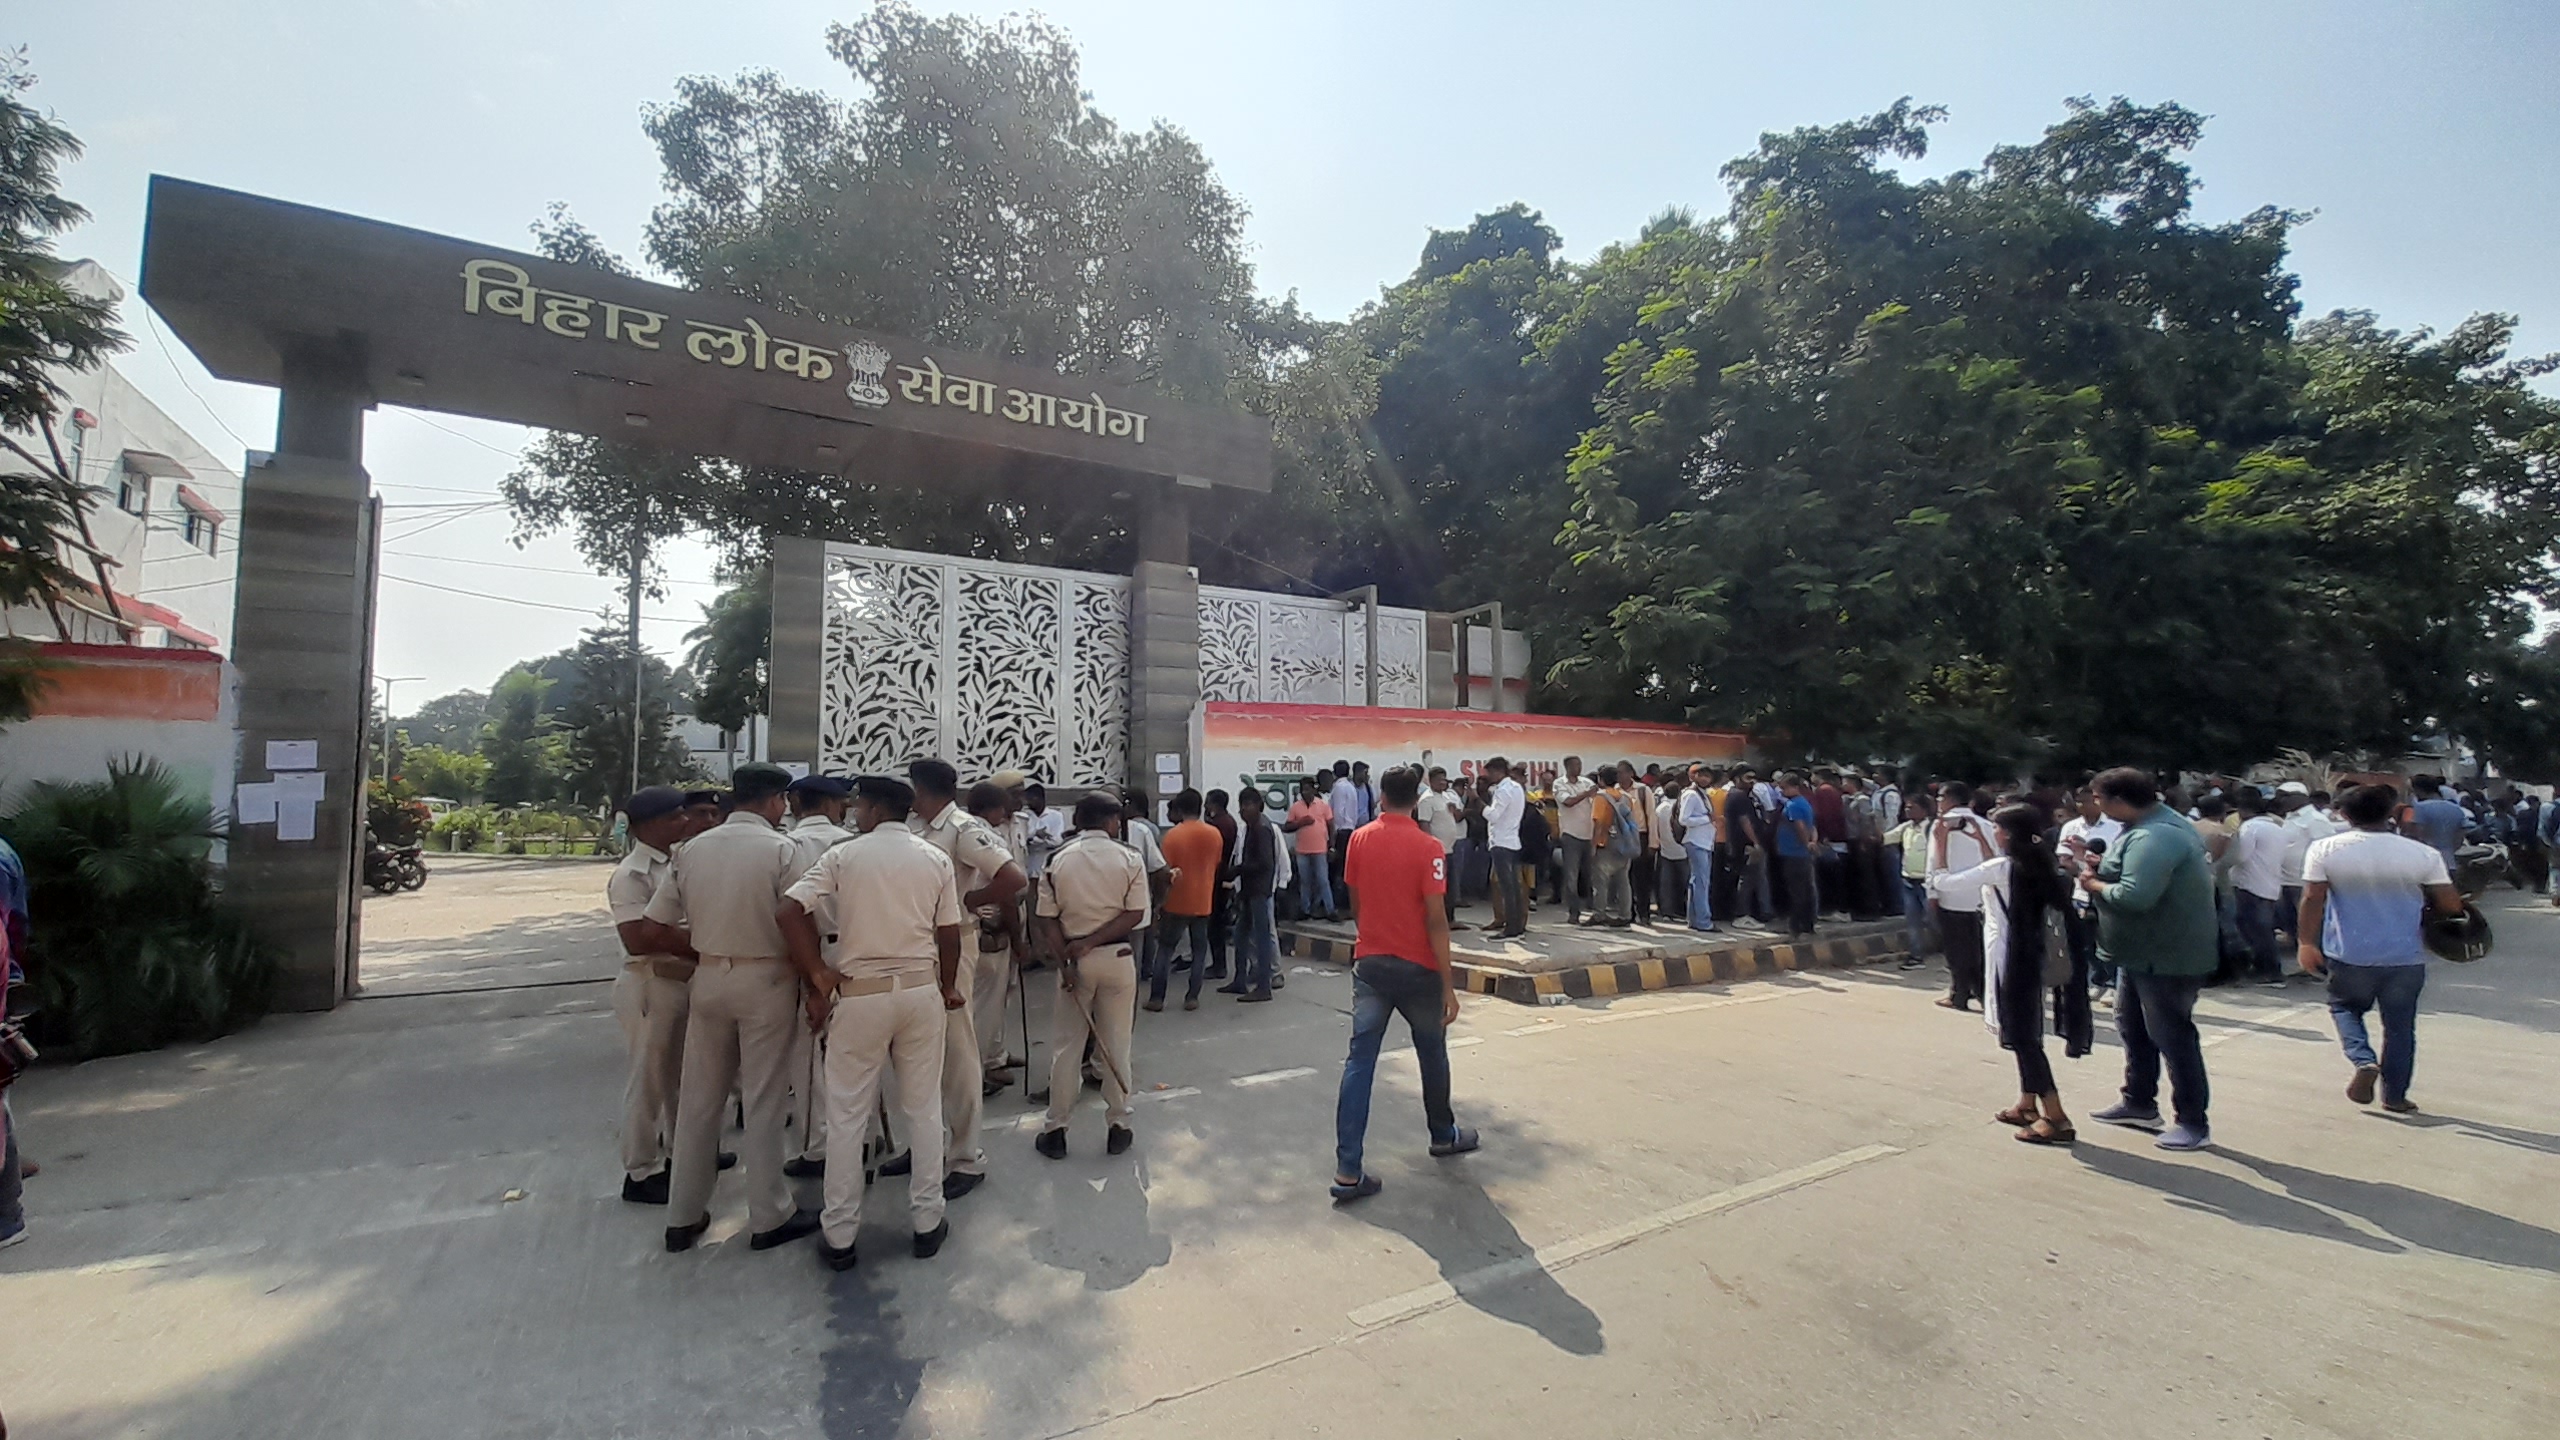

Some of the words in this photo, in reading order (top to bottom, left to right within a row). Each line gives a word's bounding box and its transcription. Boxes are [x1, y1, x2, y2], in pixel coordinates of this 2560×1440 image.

[459, 258, 669, 350] बिहार
[685, 315, 839, 380] लोक
[896, 355, 998, 415] सेवा
[1001, 391, 1149, 443] आयोग
[1432, 857, 1444, 881] 3
